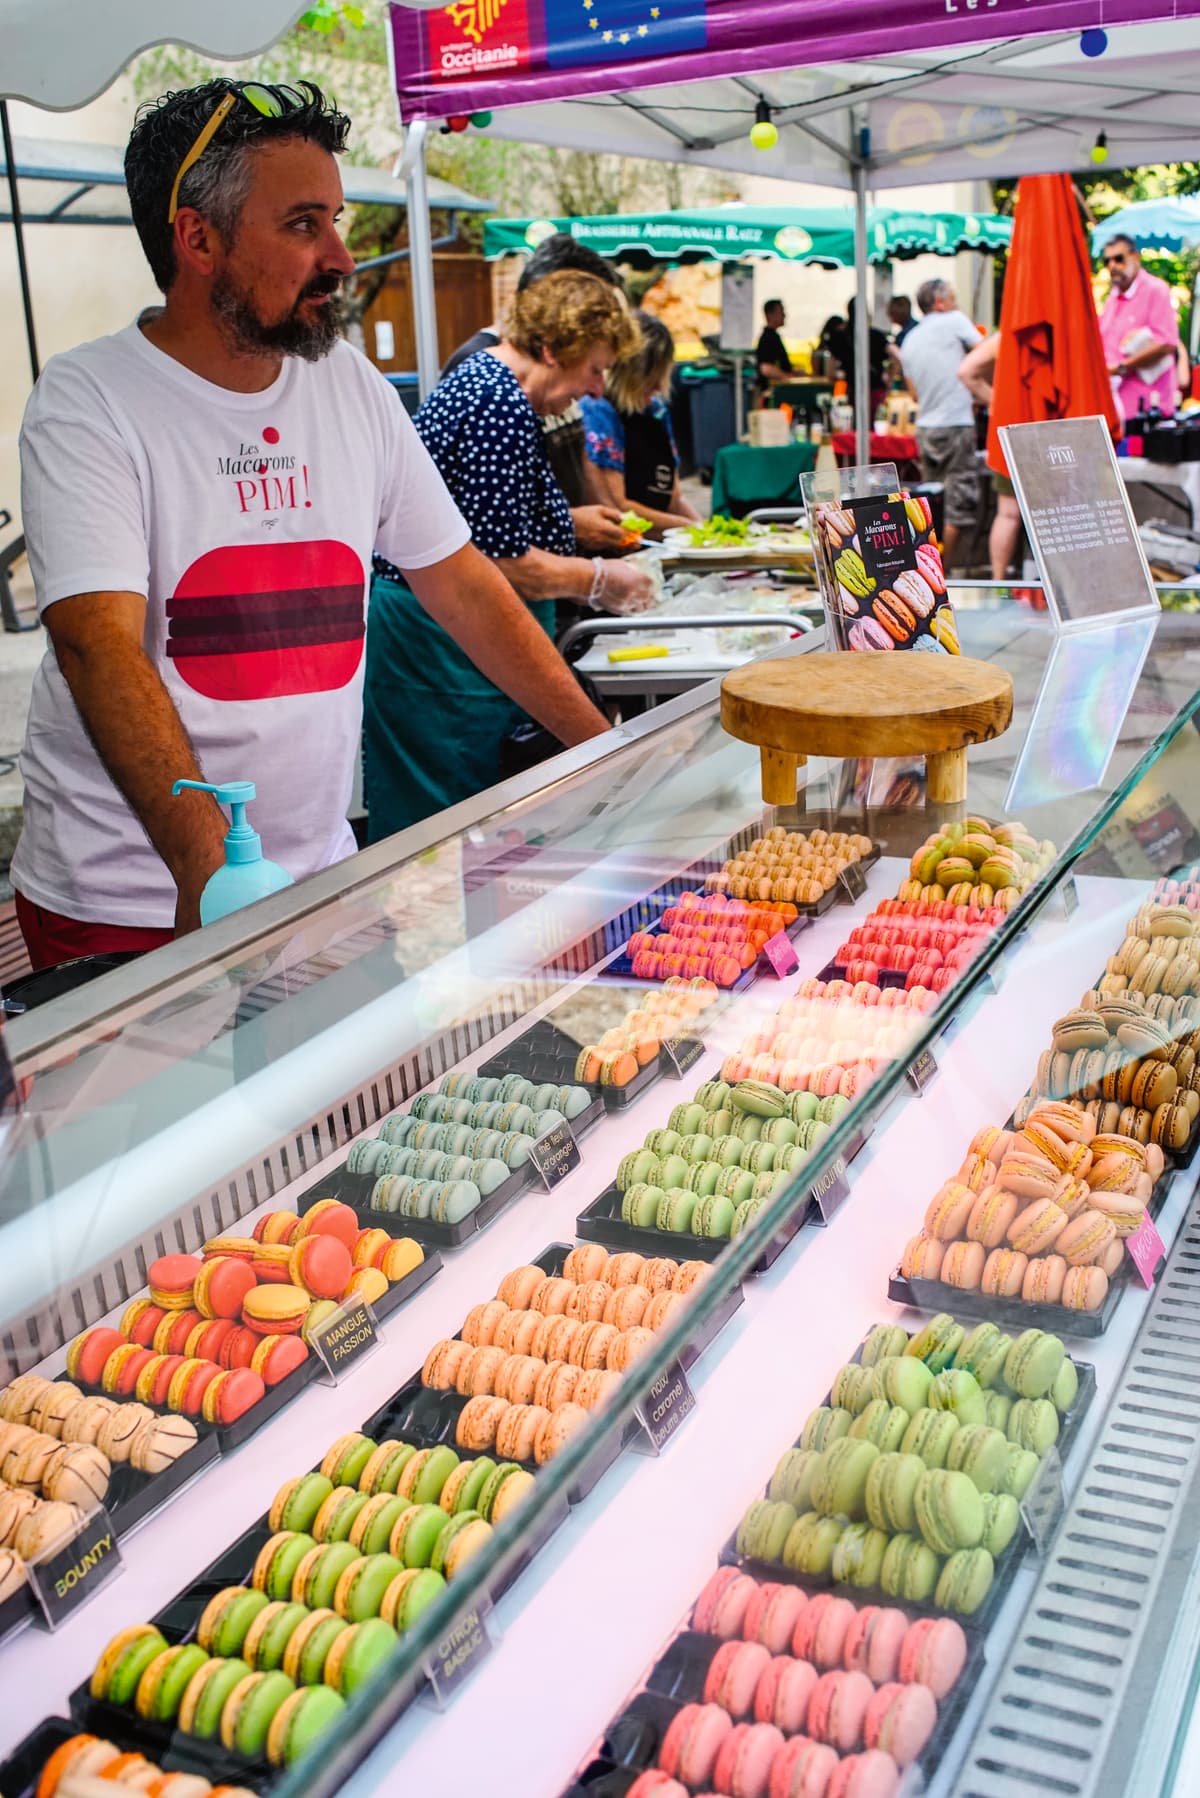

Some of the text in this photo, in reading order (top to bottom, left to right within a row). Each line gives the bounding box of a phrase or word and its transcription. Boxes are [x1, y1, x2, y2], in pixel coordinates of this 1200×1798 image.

[441, 43, 518, 69] Occitanie
[217, 455, 296, 475] Macarons
[239, 443, 259, 456] Les
[865, 523, 897, 535] Macarons
[817, 1160, 844, 1197] MOJITO
[325, 1310, 367, 1347] MANGUE
[333, 1324, 373, 1361] PASSION
[652, 1378, 684, 1422] caramel
[652, 1412, 679, 1445] beurre
[54, 1533, 112, 1598] BOUNTY
[438, 1608, 479, 1658] CITRON
[443, 1628, 483, 1677] BASILIC
